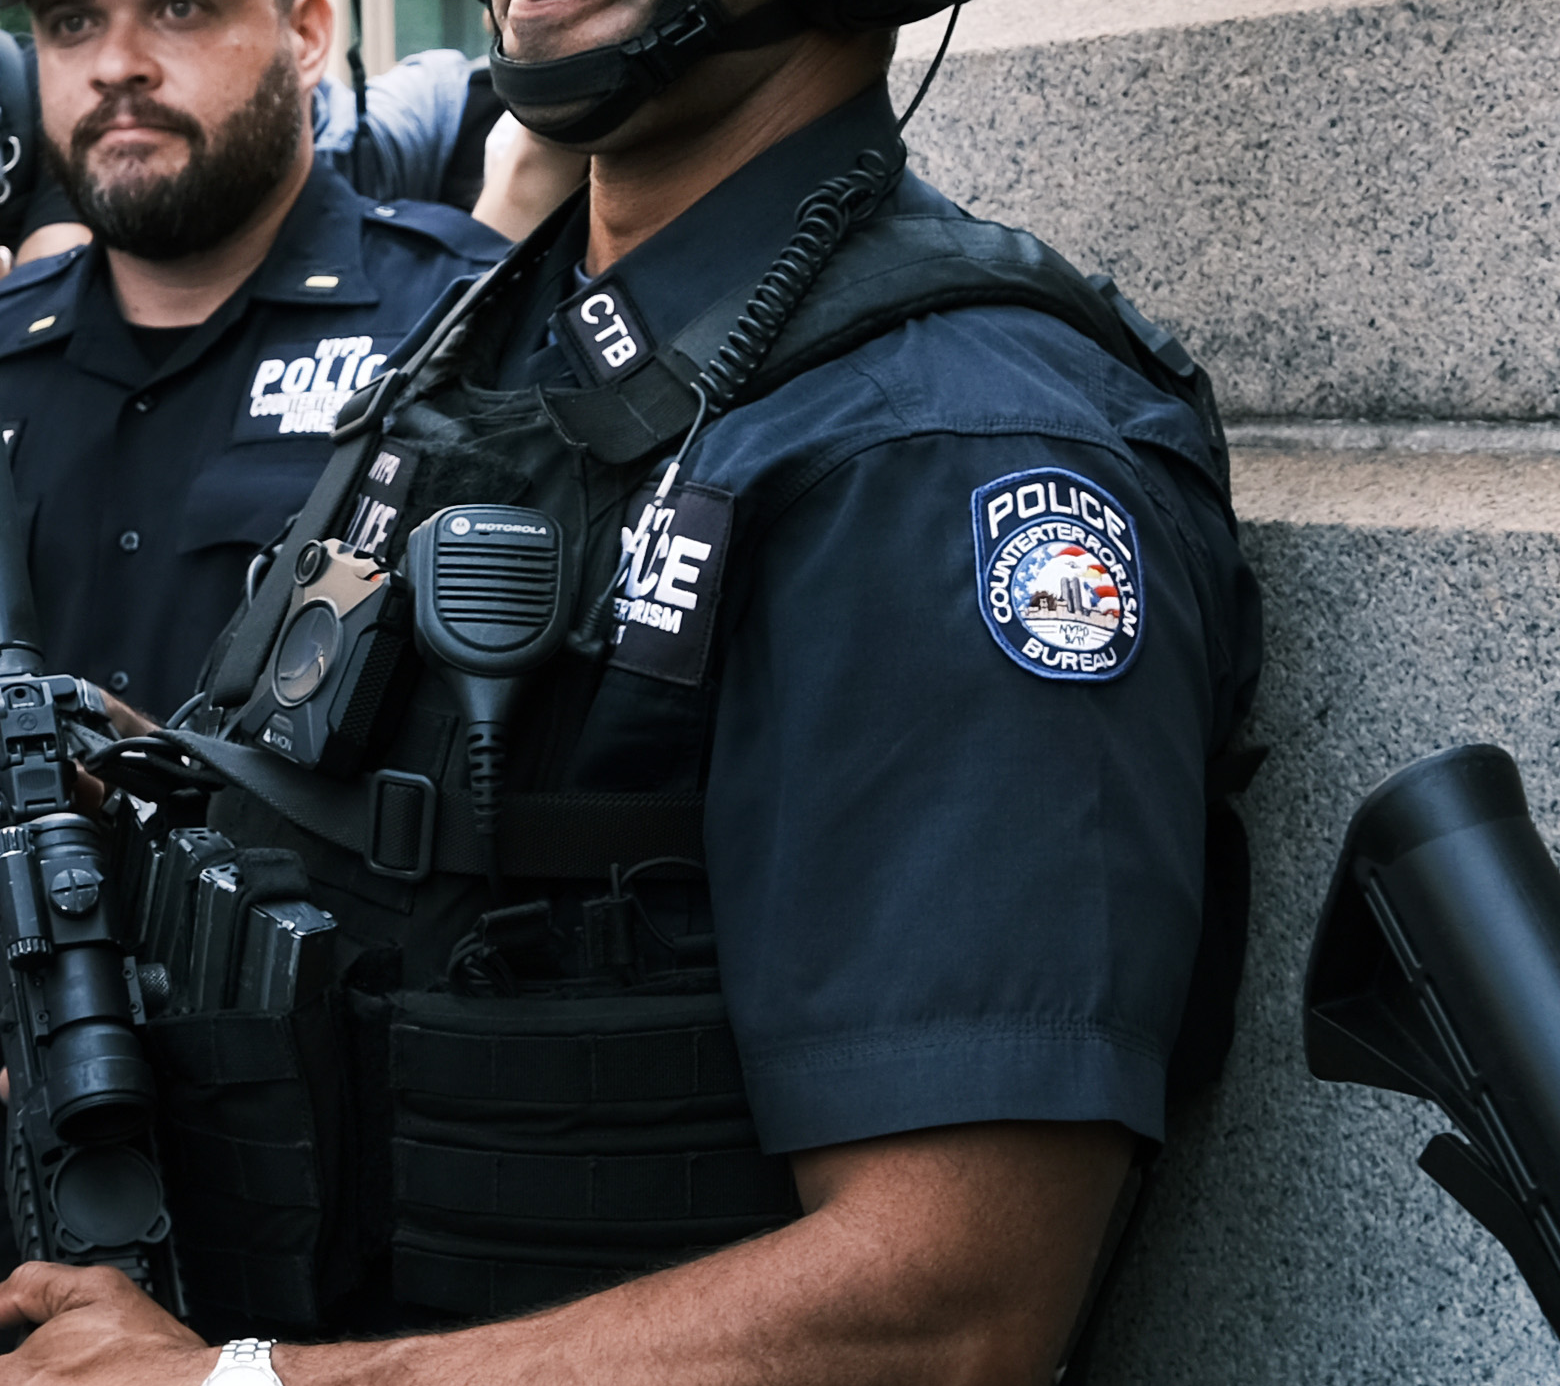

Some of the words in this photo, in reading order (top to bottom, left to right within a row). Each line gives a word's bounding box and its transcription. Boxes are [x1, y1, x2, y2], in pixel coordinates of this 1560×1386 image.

[314, 335, 374, 360] NYPD
[581, 293, 637, 368] CTB
[249, 354, 388, 399] POLIC
[474, 522, 547, 535] MOTOROLA
[987, 481, 1133, 562] POLICE
[989, 521, 1139, 638] COUNTERTERRORISM
[1059, 623, 1090, 637] NYPD
[1021, 636, 1118, 673] BUREAU
